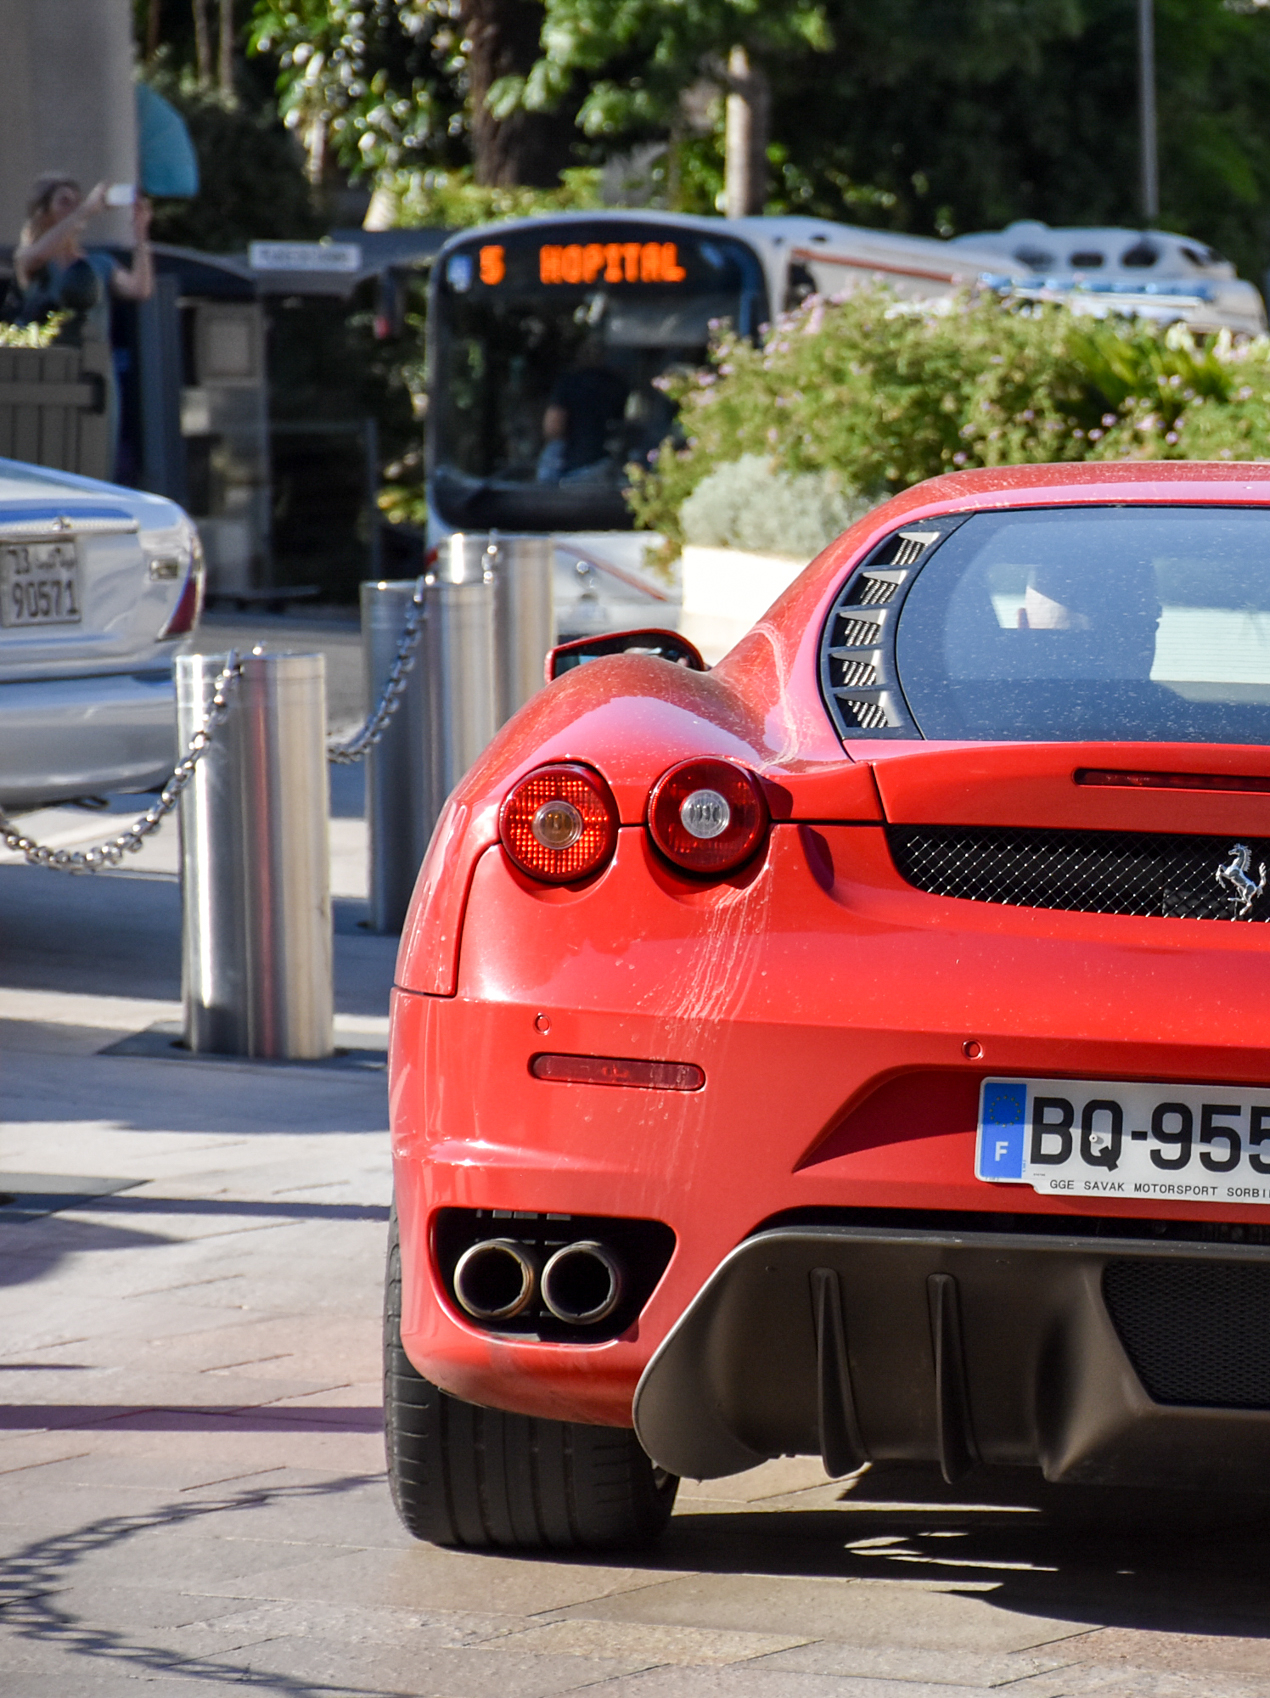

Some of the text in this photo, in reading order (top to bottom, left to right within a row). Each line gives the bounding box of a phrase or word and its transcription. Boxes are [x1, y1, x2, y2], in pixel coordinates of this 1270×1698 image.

[479, 242, 687, 286] 5 HOPITAL
[12, 580, 79, 619] 90571
[994, 1141, 1009, 1162] F
[1049, 1179, 1075, 1190] GGE
[1083, 1180, 1125, 1192] SAVAK
[1133, 1182, 1219, 1196] MOTORSPORT
